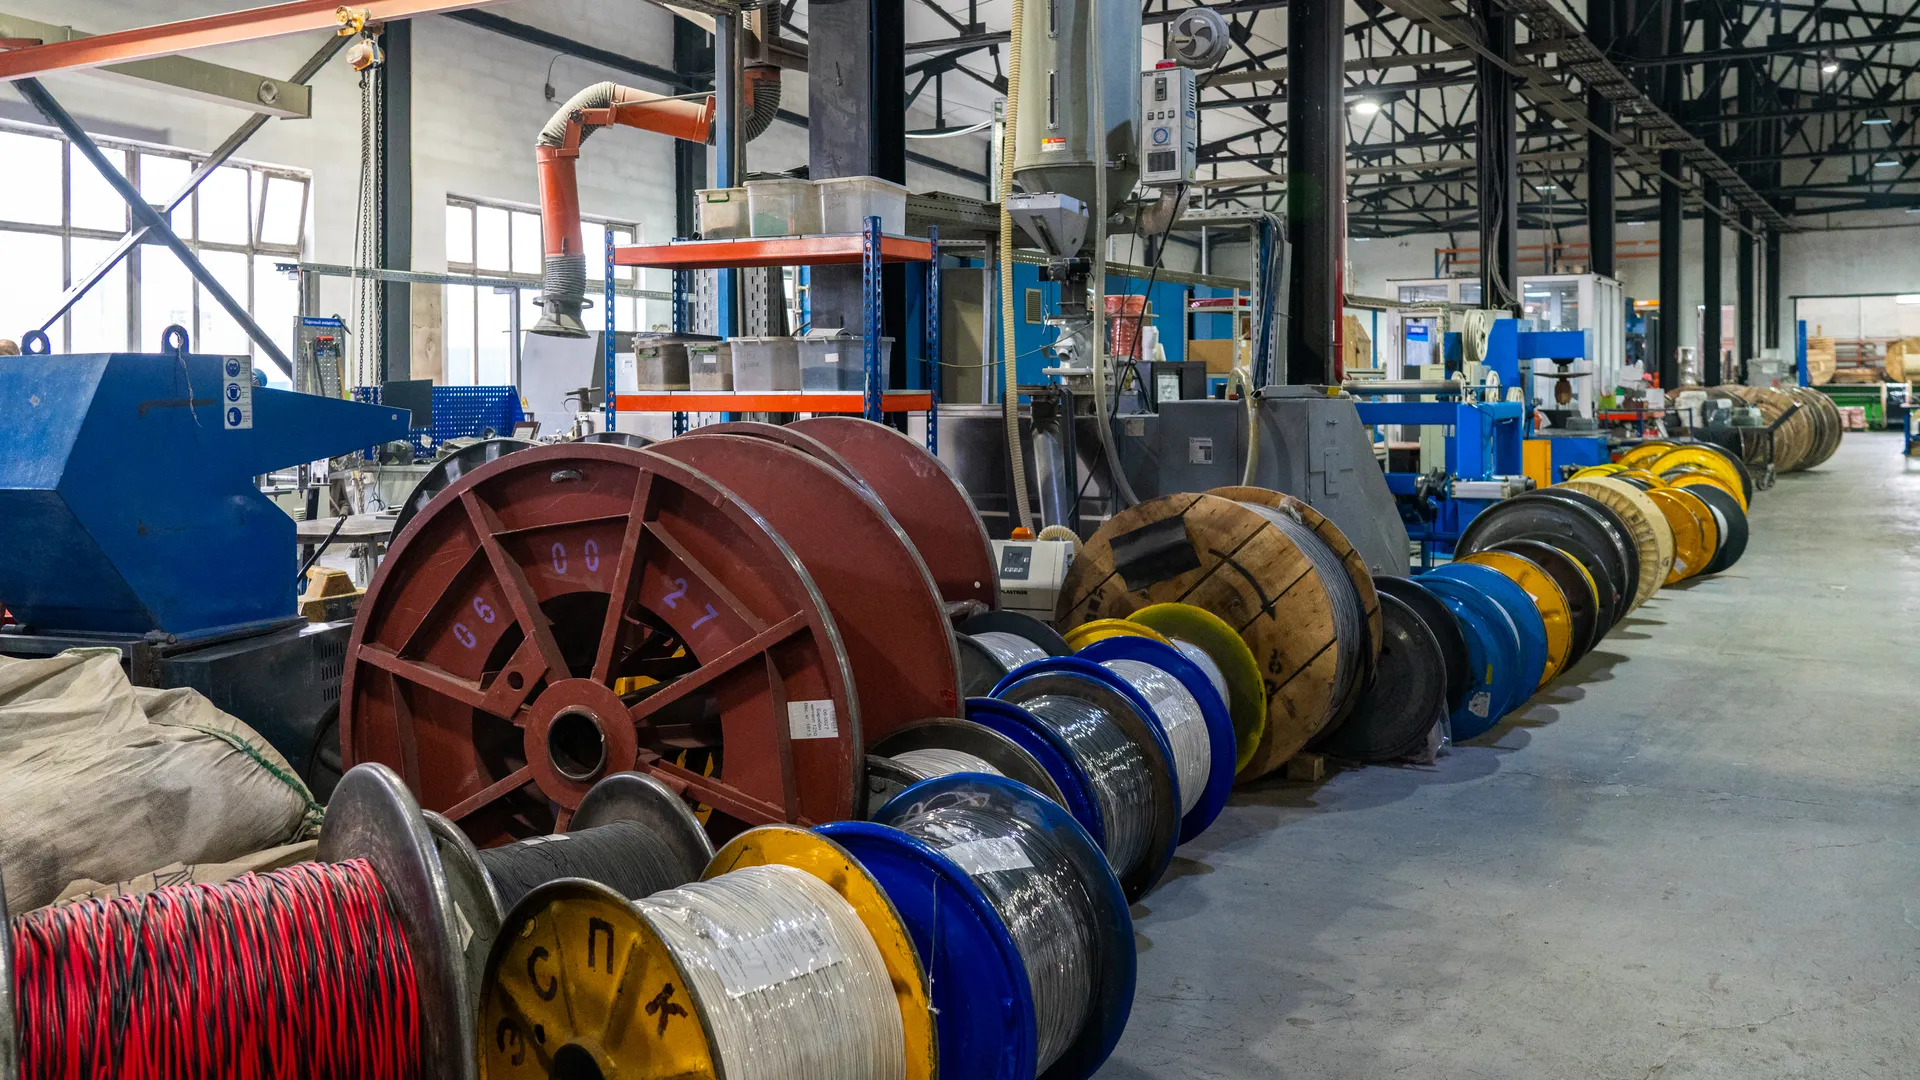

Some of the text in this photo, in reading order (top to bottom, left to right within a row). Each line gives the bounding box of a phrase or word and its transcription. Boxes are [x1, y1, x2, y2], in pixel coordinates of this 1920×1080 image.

[453, 539, 719, 649] 06 00 27
